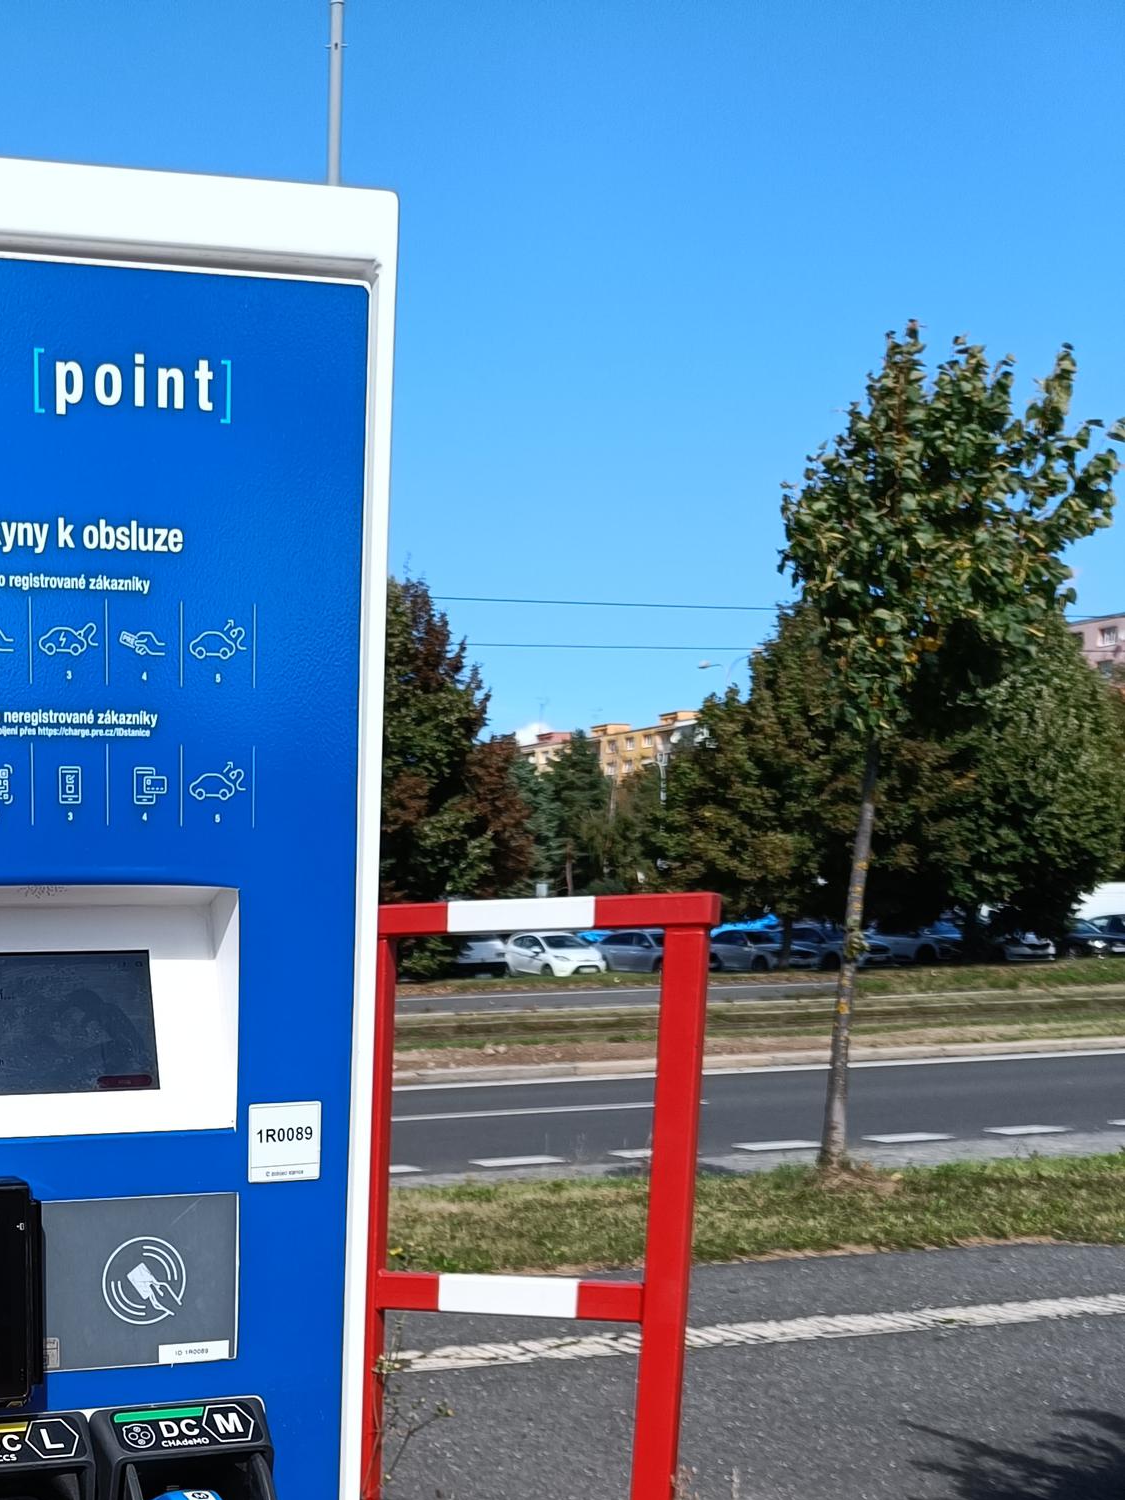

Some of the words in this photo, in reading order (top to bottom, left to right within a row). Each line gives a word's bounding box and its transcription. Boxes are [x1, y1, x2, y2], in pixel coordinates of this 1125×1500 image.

[57, 517, 74, 548] k
[83, 519, 184, 553] obsluze
[9, 573, 86, 592] registrované
[88, 575, 150, 595] zákazníky
[66, 670, 72, 680] 3
[141, 671, 147, 681] 4
[215, 673, 221, 683] 5
[4, 709, 94, 726] neregistrované
[97, 711, 157, 727] zákazníky
[67, 812, 73, 821] 3
[141, 812, 147, 821] 4
[215, 813, 220, 822] 5
[257, 1126, 313, 1143] 1R0089
[159, 1419, 200, 1438] DC
[213, 1412, 244, 1434] M
[39, 1428, 64, 1449] L
[161, 1437, 210, 1448] CHAdeMO
